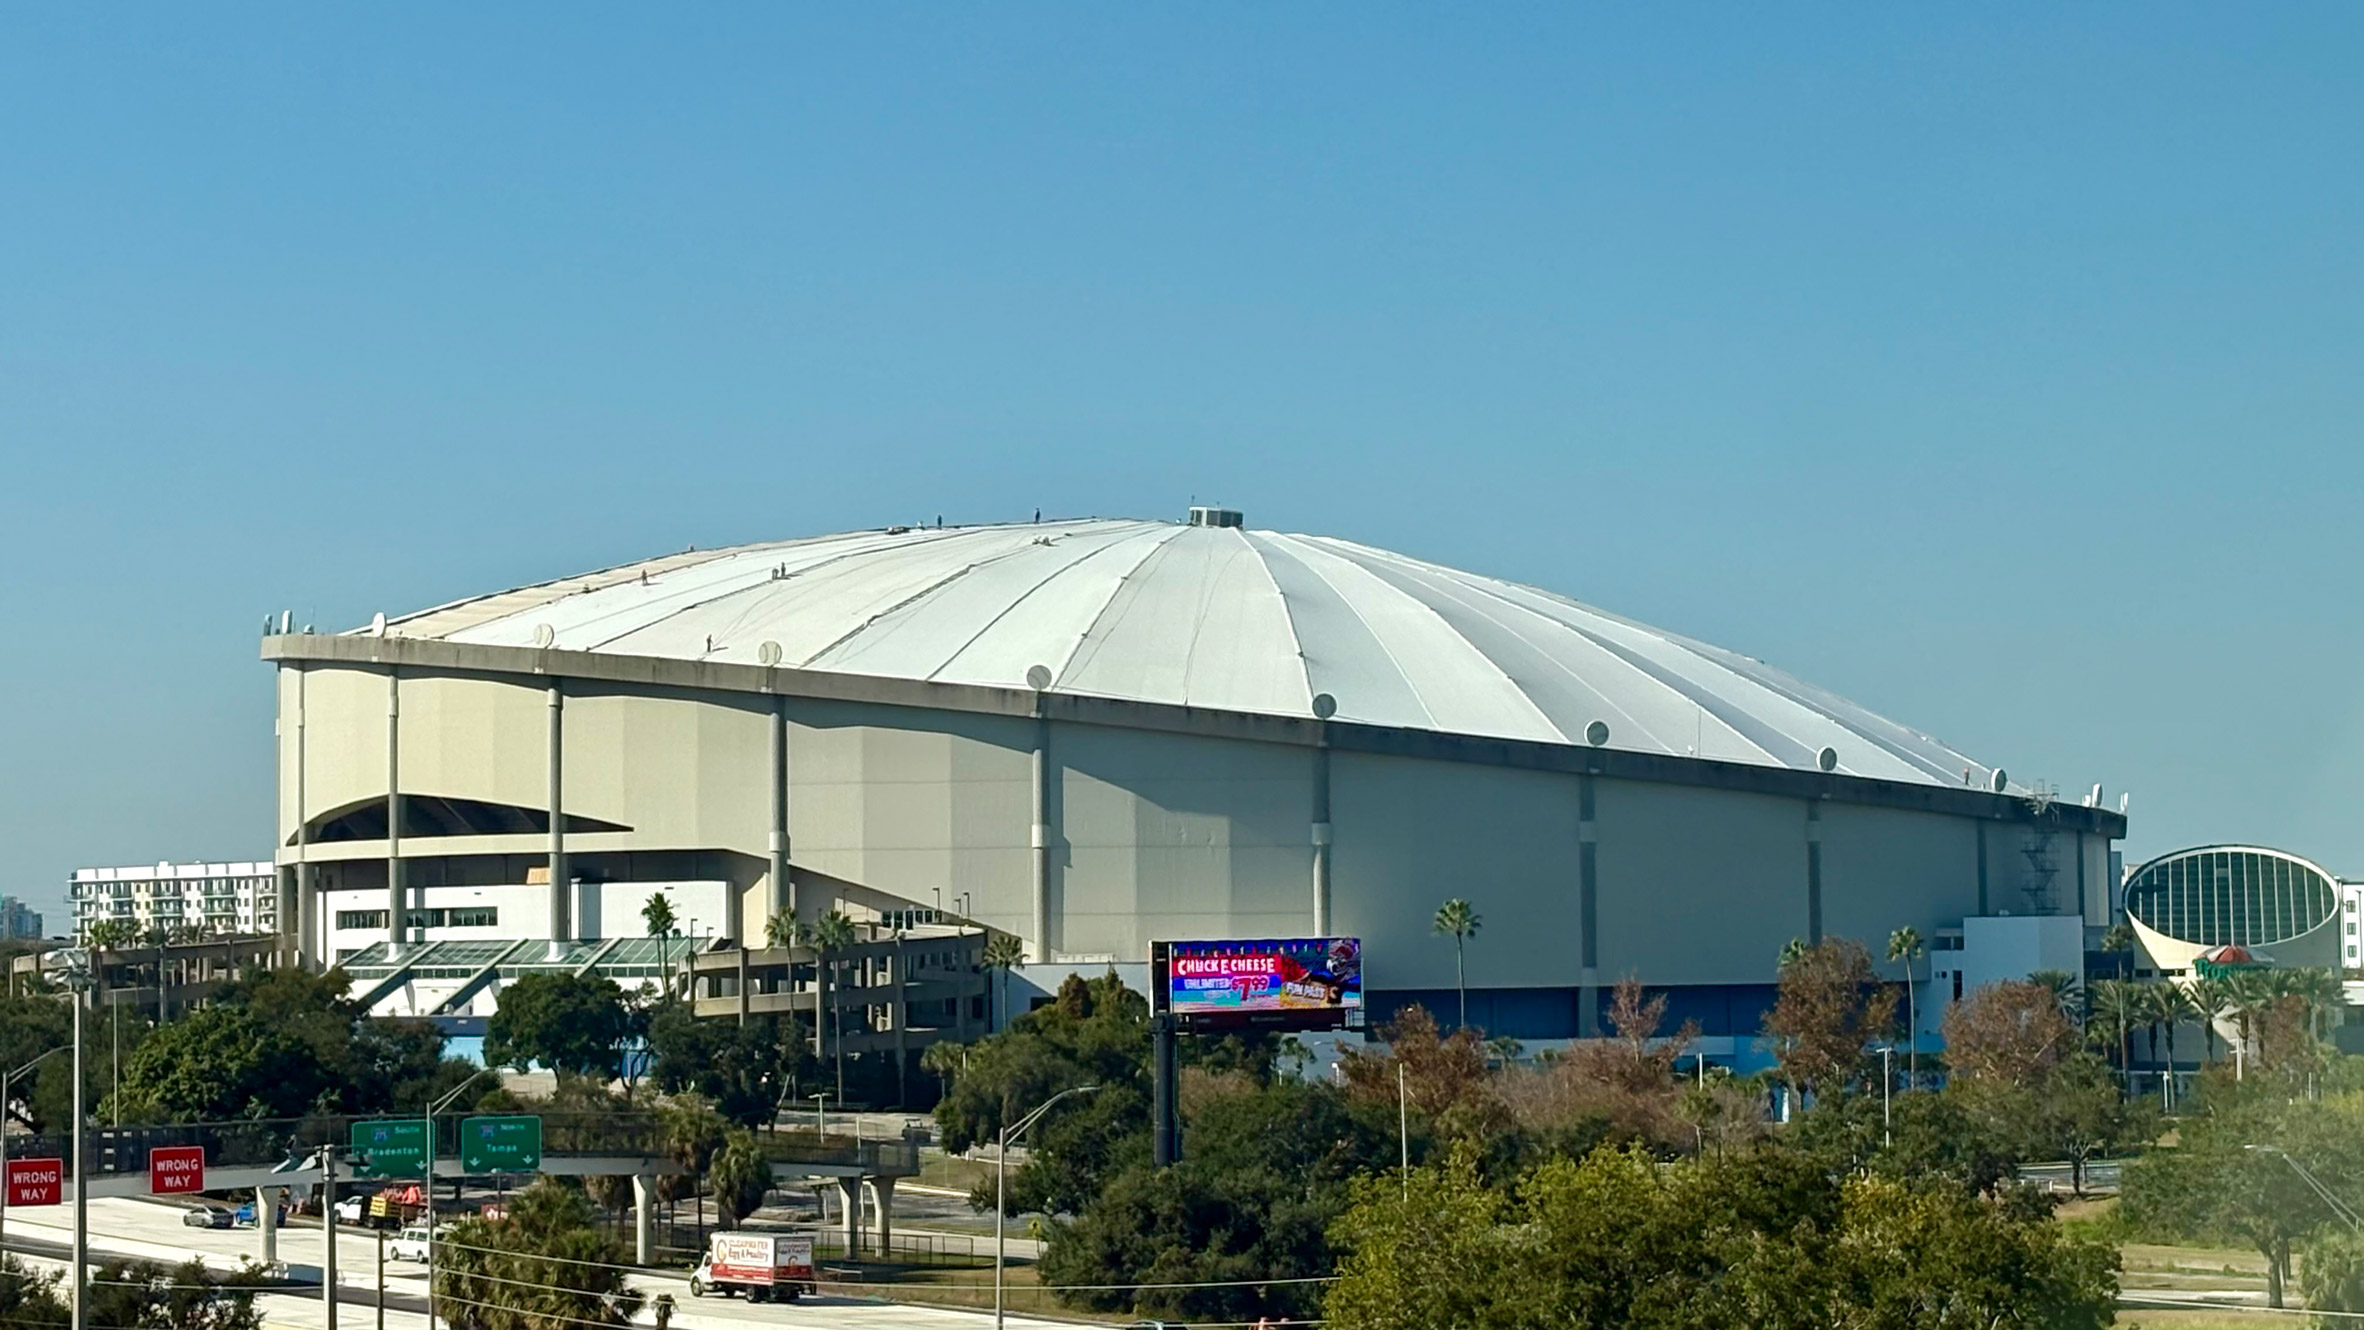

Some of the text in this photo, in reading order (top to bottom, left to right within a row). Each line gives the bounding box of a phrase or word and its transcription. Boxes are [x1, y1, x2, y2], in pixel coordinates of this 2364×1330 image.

[1177, 957, 1275, 975] CHUCK E CHEESE
[486, 1143, 518, 1153] Tampa
[156, 1158, 199, 1172] WRONG
[13, 1170, 57, 1184] WRONG
[164, 1174, 191, 1188] WAY
[20, 1187, 48, 1201] WAY
